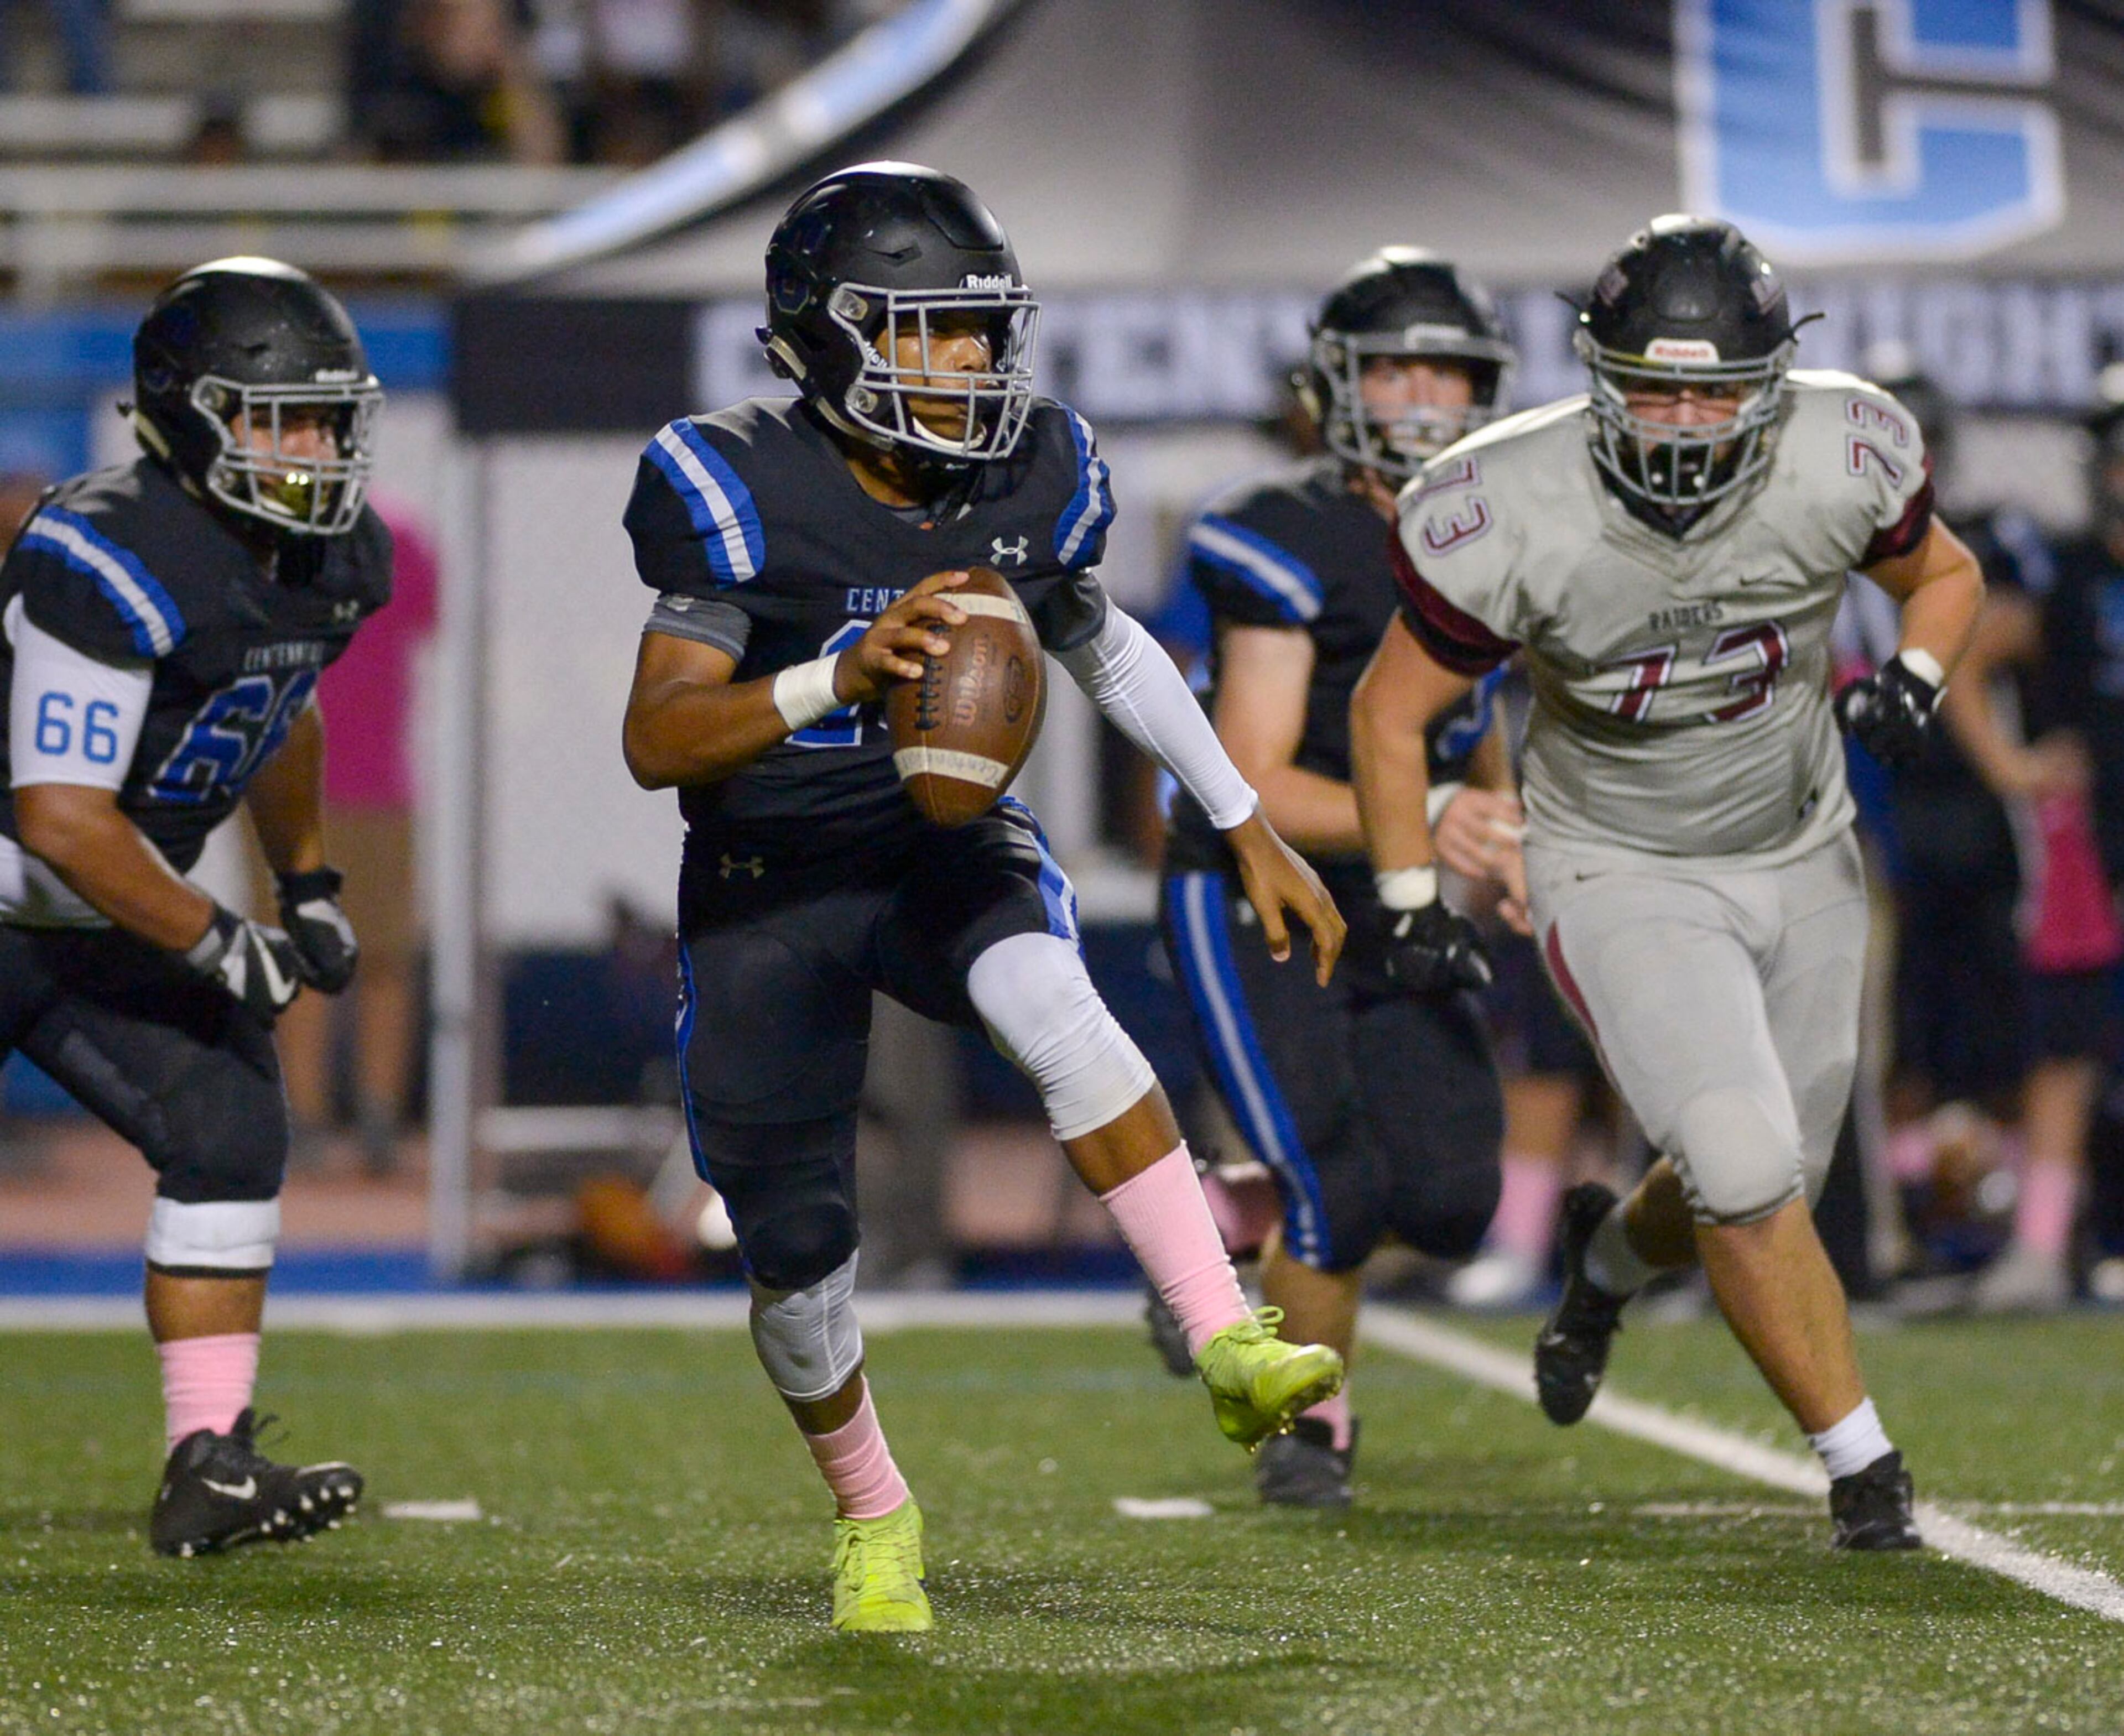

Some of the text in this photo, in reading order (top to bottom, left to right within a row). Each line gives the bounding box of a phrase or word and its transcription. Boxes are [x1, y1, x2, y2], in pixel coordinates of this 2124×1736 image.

[1846, 399, 1908, 489] 73
[847, 588, 905, 612] CENT
[1596, 619, 1789, 723] 73
[35, 691, 119, 764] 66
